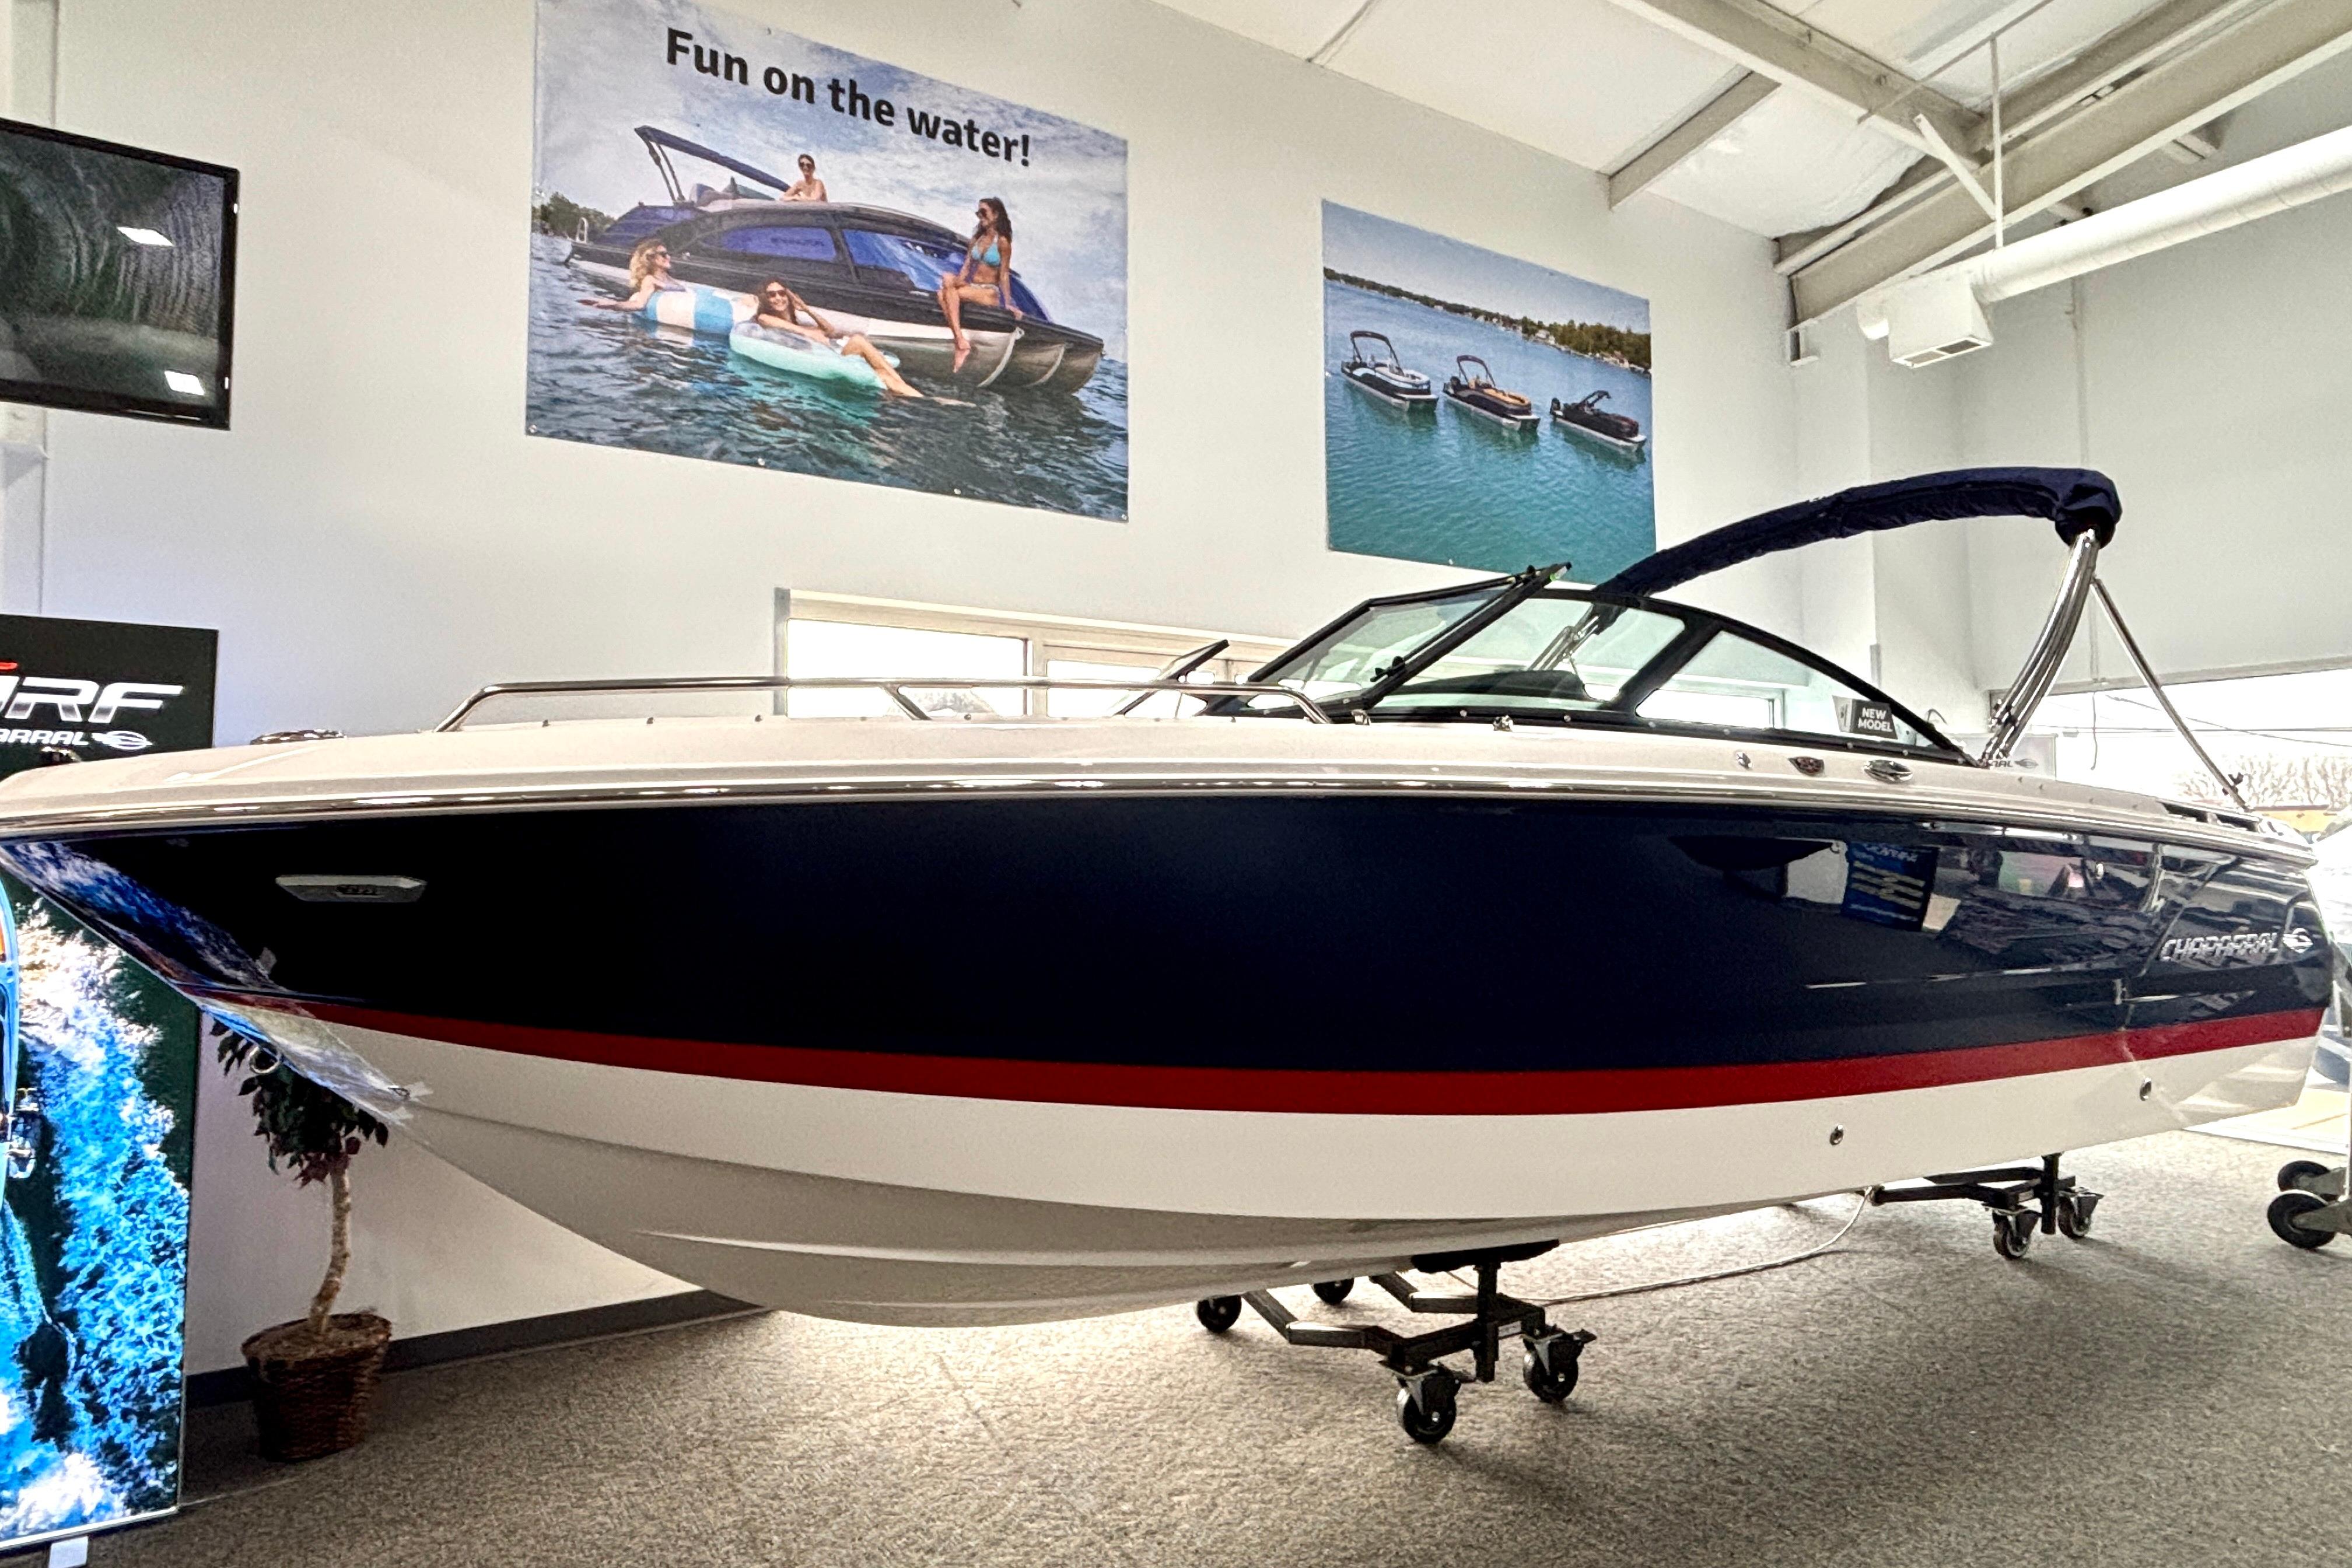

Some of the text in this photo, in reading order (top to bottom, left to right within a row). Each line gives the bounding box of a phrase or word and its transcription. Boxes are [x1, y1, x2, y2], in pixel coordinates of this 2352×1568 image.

[666, 27, 1030, 167] Fun on the water!
[1862, 707, 1887, 720] NEW
[1857, 717, 1894, 733] MODEL
